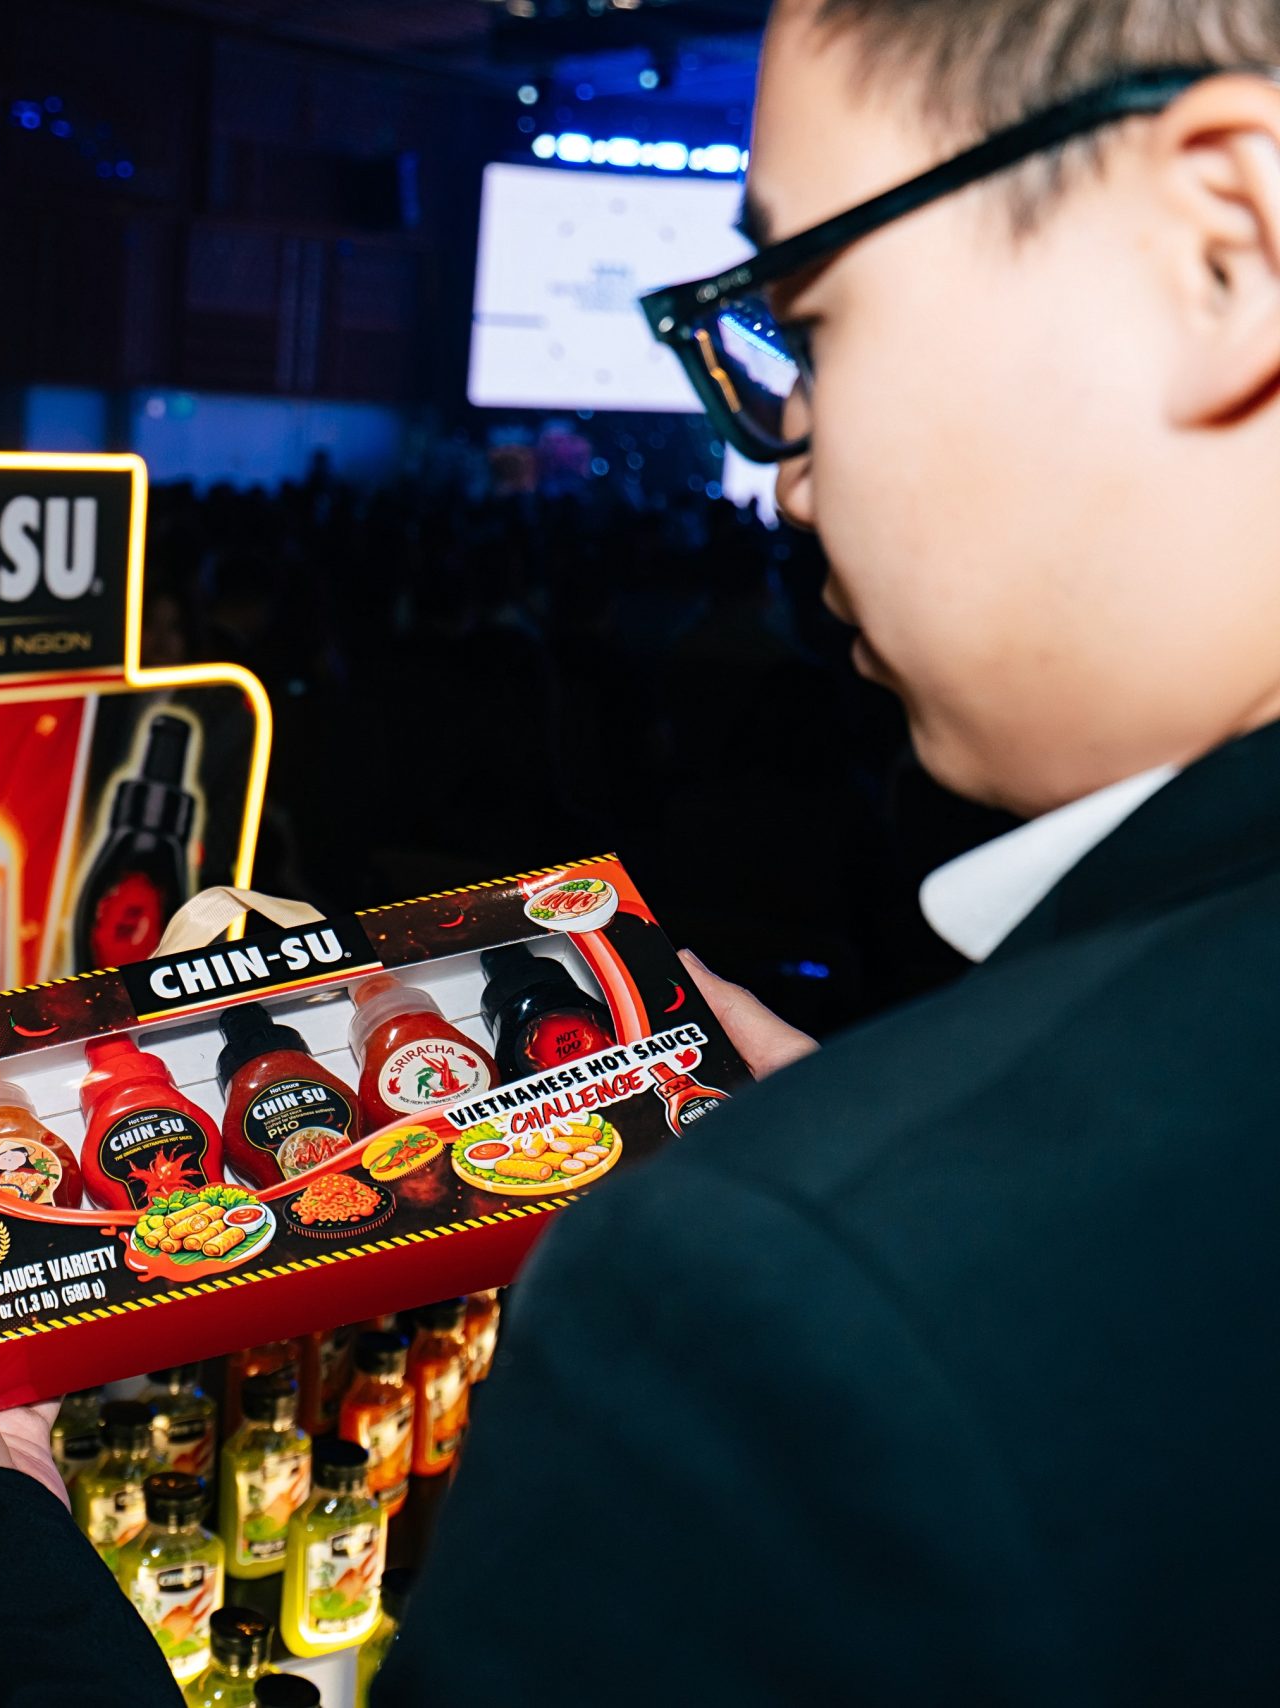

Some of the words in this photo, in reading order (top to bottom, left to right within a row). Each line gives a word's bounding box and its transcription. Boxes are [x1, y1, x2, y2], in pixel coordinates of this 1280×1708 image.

[149, 929, 344, 999] CHIN-SU
[556, 1029, 579, 1045] HOT
[556, 1040, 581, 1059] 100
[390, 1044, 455, 1074] SRIRACHA
[270, 1087, 281, 1095] Hot
[281, 1083, 300, 1091] Sauce
[448, 1064, 587, 1127] VIETNAMESE
[584, 1050, 631, 1078] HOT
[631, 1026, 704, 1060] SAUCE
[252, 1087, 327, 1120] CHIN-SU
[510, 1066, 646, 1134] CHALLENGE
[680, 1099, 719, 1124] CHIN-SU
[109, 1118, 184, 1152] CHIN-SU
[128, 1118, 139, 1126] Hot
[140, 1113, 158, 1122] Sauce
[267, 1120, 299, 1139] PHO
[47, 1245, 118, 1283] VARIETY
[0, 1302, 14, 1319] oz
[14, 1294, 40, 1317] (1.3
[40, 1289, 58, 1310] lb)
[61, 1282, 91, 1306] (580
[91, 1279, 106, 1299] g)
